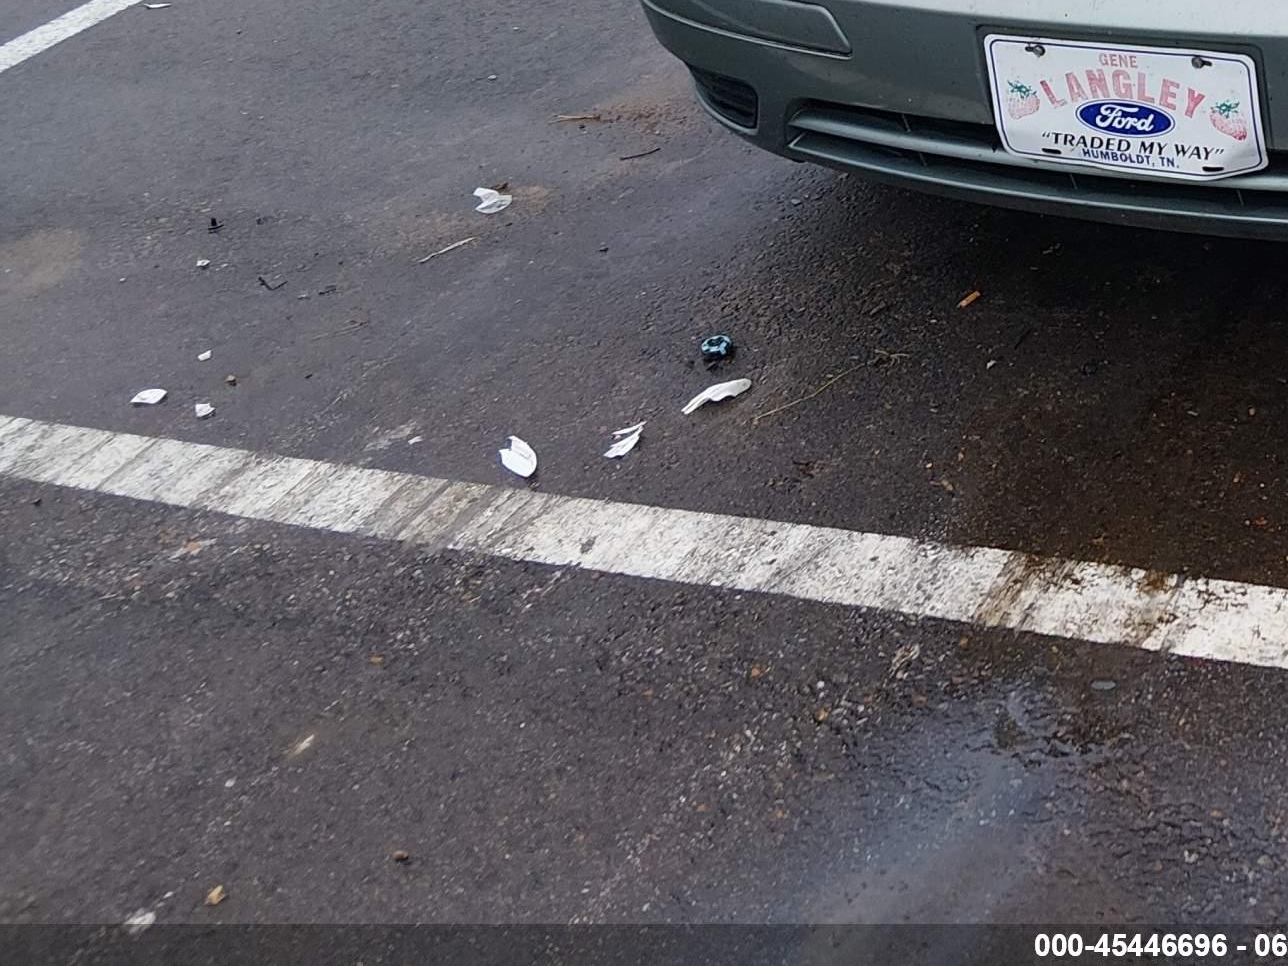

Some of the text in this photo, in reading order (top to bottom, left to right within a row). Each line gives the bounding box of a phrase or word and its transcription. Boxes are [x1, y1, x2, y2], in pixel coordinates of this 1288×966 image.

[1099, 53, 1138, 68] GENE
[1039, 68, 1206, 119] LANGLEY
[1095, 104, 1155, 133] Ford
[1138, 140, 1167, 155] MY
[1082, 148, 1180, 169] HUMBOLDT, TN.
